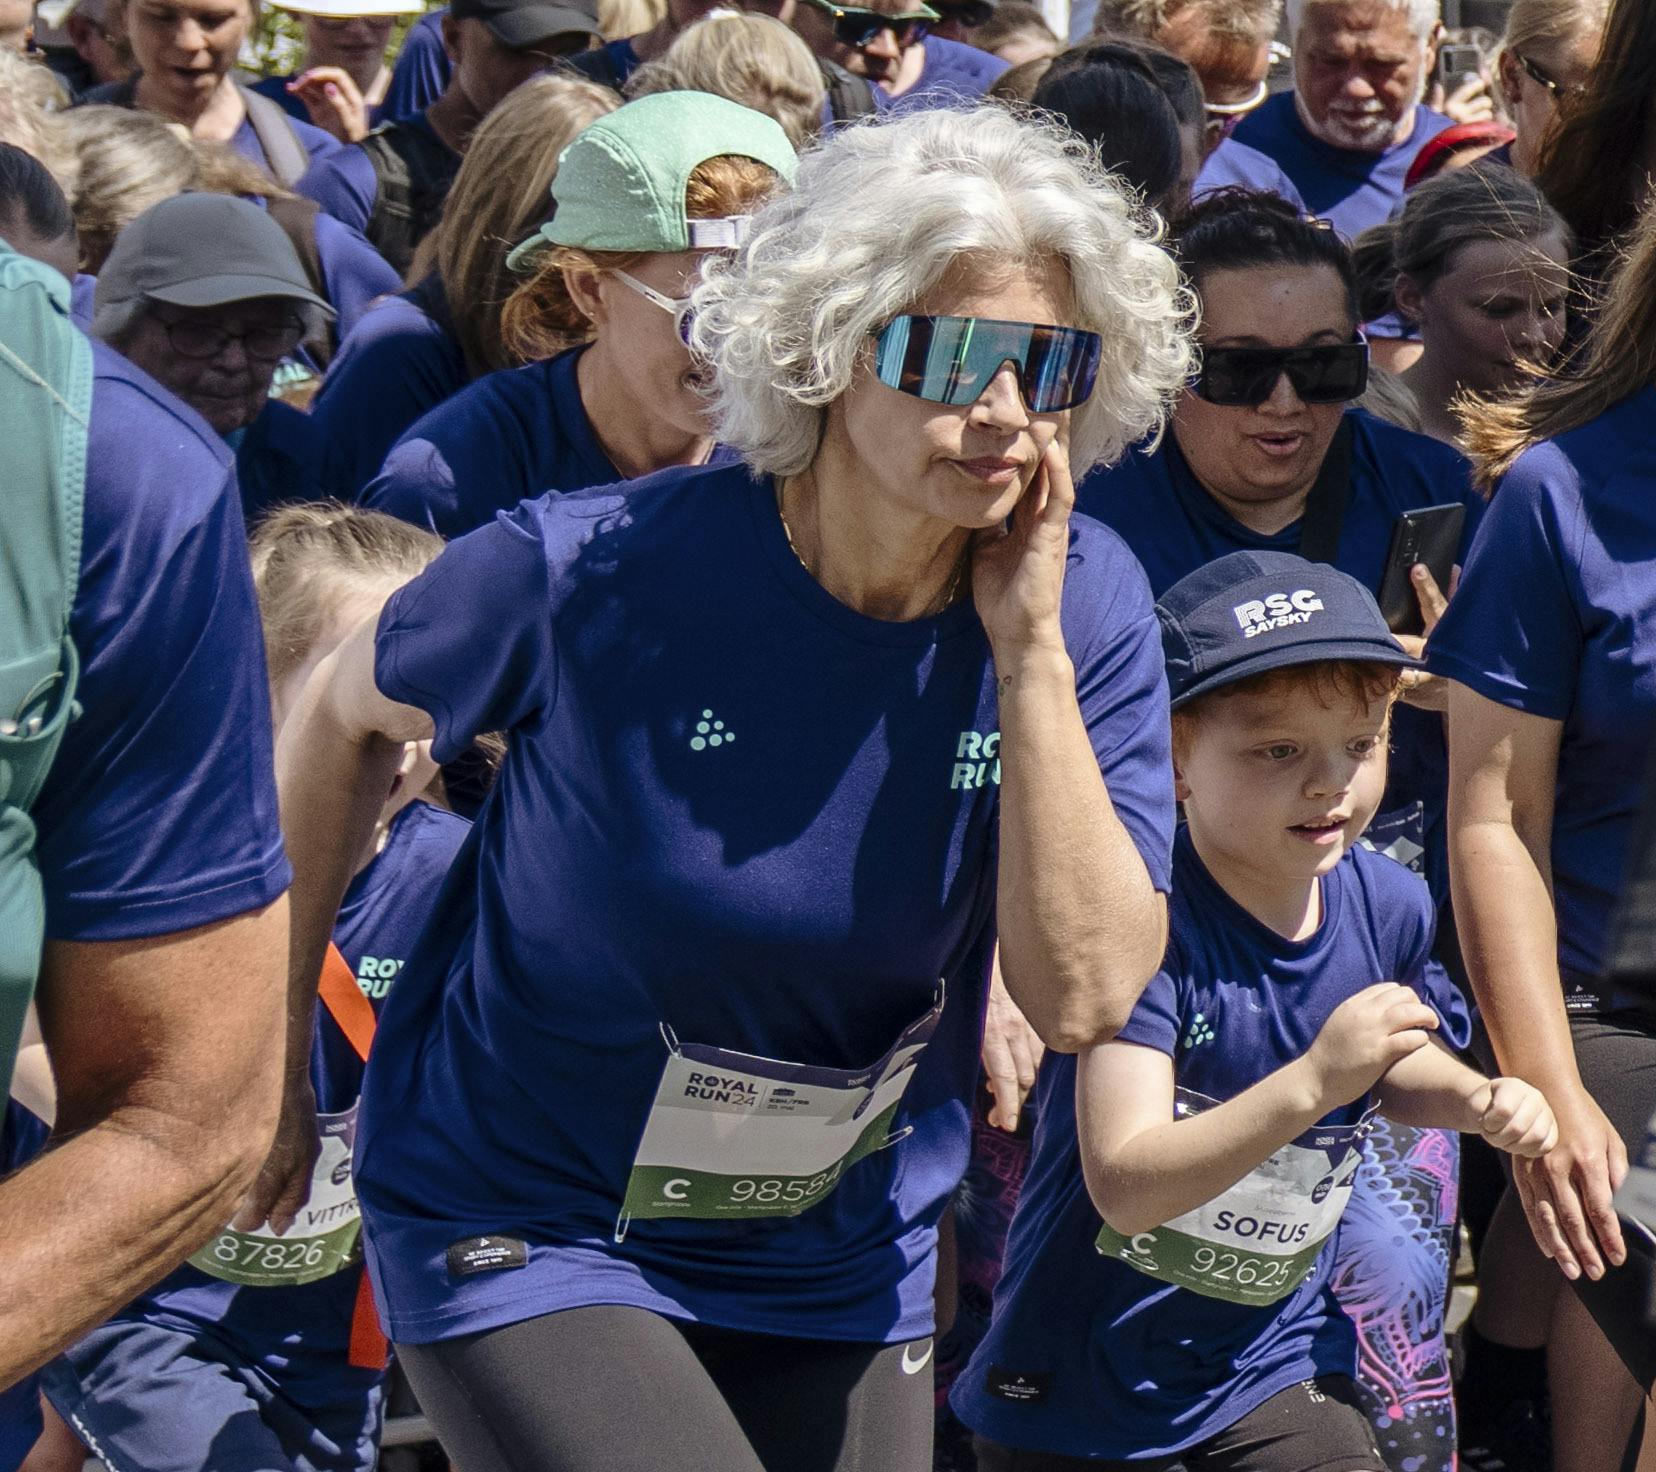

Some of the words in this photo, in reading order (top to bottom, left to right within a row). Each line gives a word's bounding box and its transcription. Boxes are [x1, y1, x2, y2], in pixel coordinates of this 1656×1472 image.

[1233, 589, 1325, 630] RSG
[1244, 611, 1313, 639] SAYSKY
[688, 1072, 759, 1095] ROYAL
[663, 1178, 692, 1199] C
[729, 1160, 844, 1202] 98584
[1213, 1210, 1310, 1244] SOFUS
[214, 1235, 325, 1269] 87826
[1131, 1232, 1158, 1255] C
[1190, 1248, 1294, 1286] 92625
